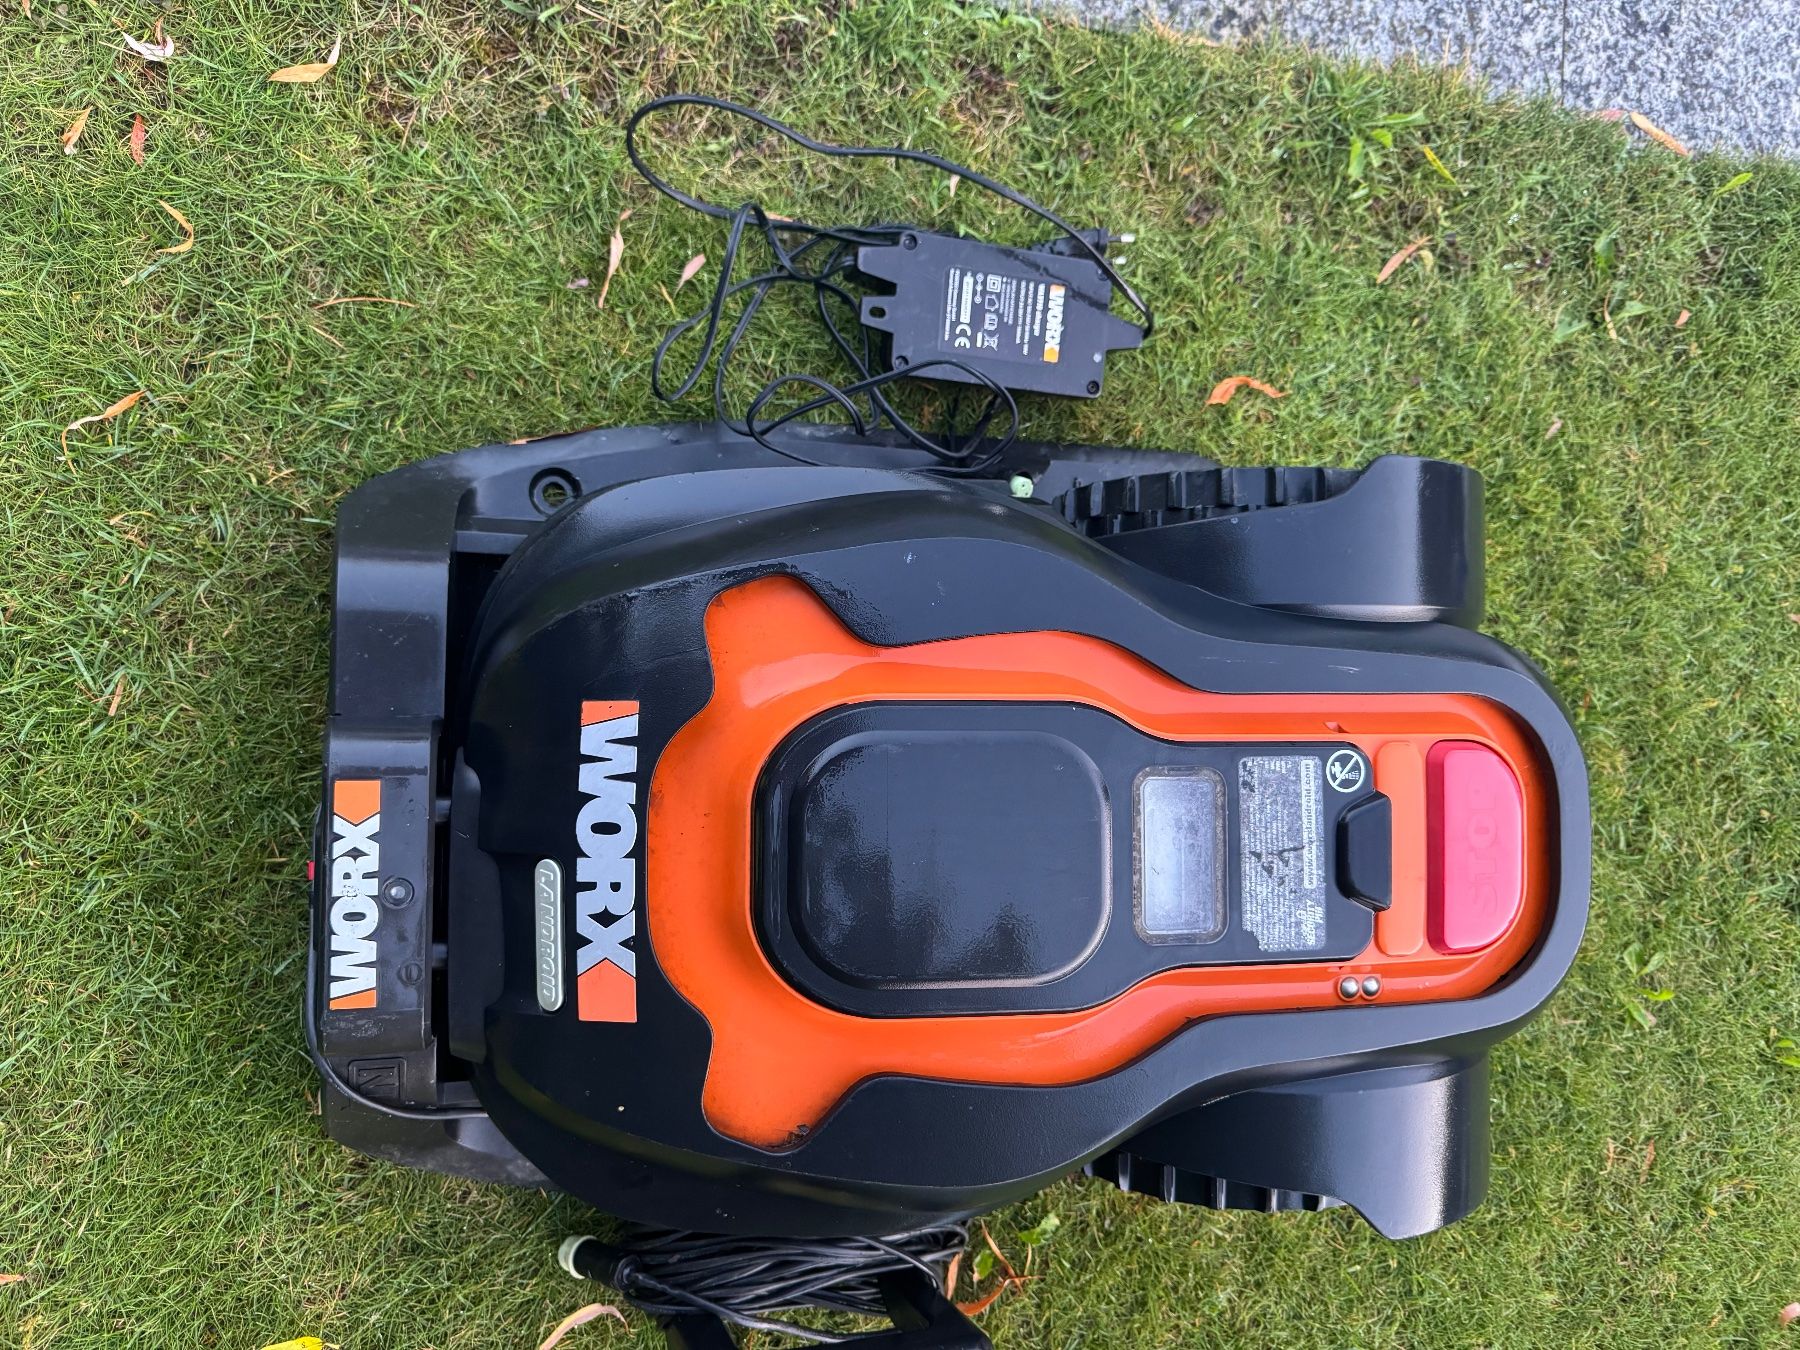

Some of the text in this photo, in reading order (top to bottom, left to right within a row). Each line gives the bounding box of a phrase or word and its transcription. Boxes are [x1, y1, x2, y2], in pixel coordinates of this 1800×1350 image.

[329, 813, 381, 998] WORX
[576, 714, 639, 977] WORX
[1465, 777, 1499, 916] STOP
[538, 869, 555, 1001] LANDROID
